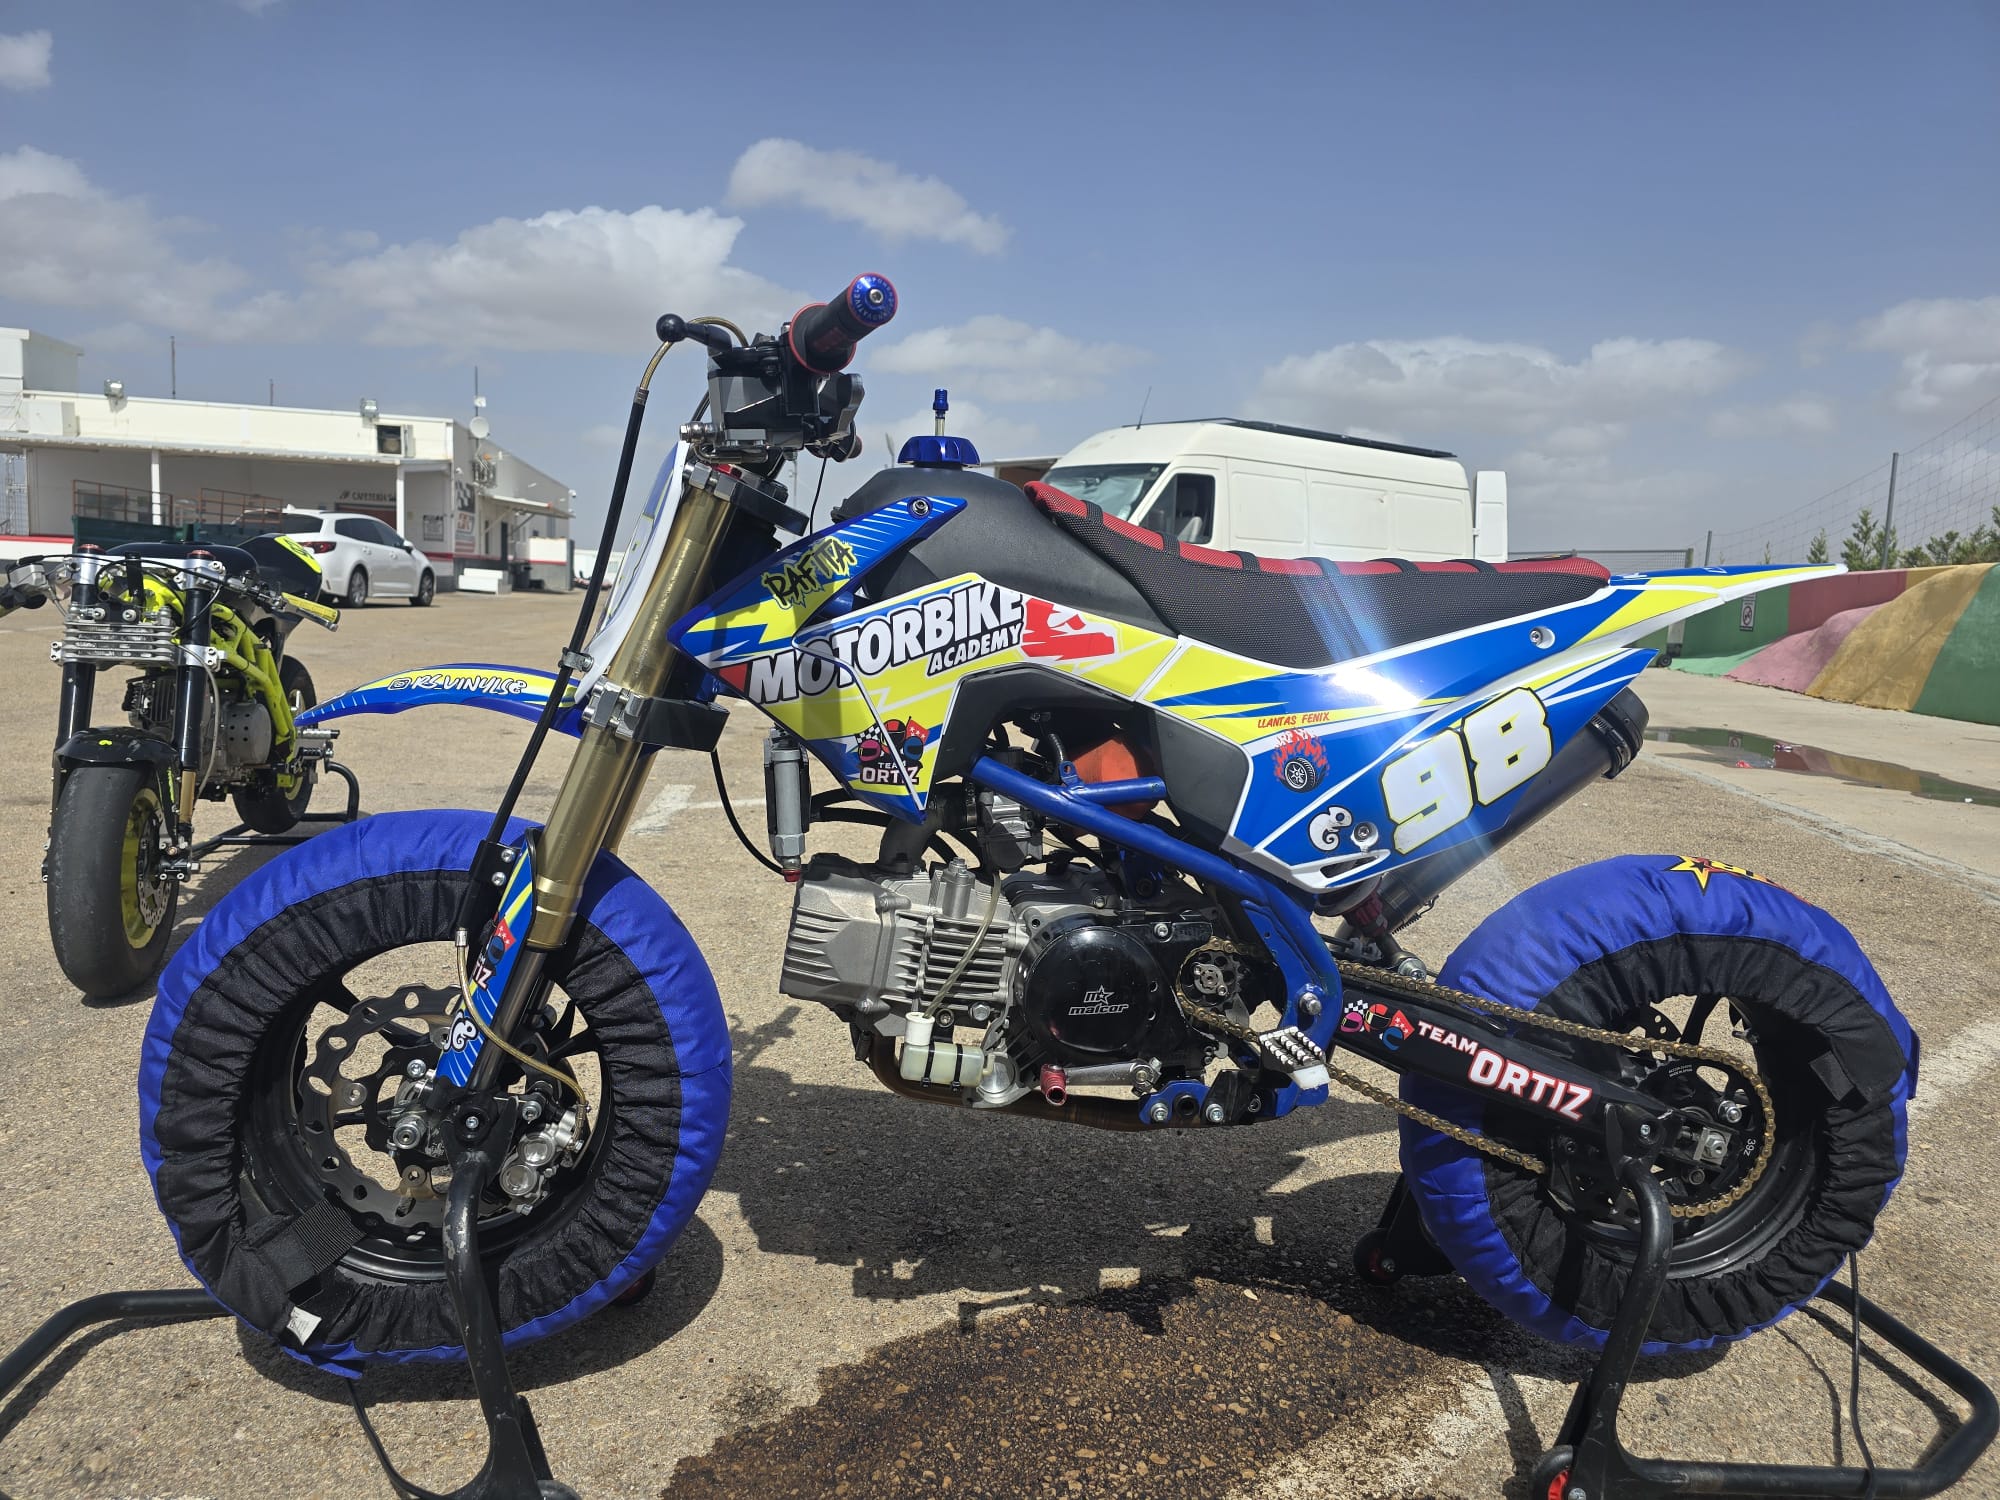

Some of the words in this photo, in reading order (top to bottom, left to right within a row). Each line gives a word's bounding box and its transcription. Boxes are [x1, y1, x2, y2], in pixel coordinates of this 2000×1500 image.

[749, 582, 1024, 704] MOTORBIKE
[927, 622, 1024, 677] ACADEMY
[1257, 715, 1297, 729] LLANTAS
[1301, 711, 1330, 724] FENIX
[861, 766, 920, 785] ORTZ
[1380, 687, 1552, 855] 98
[1417, 1020, 1479, 1057] TEAM
[1467, 1047, 1594, 1122] ORTIZ
